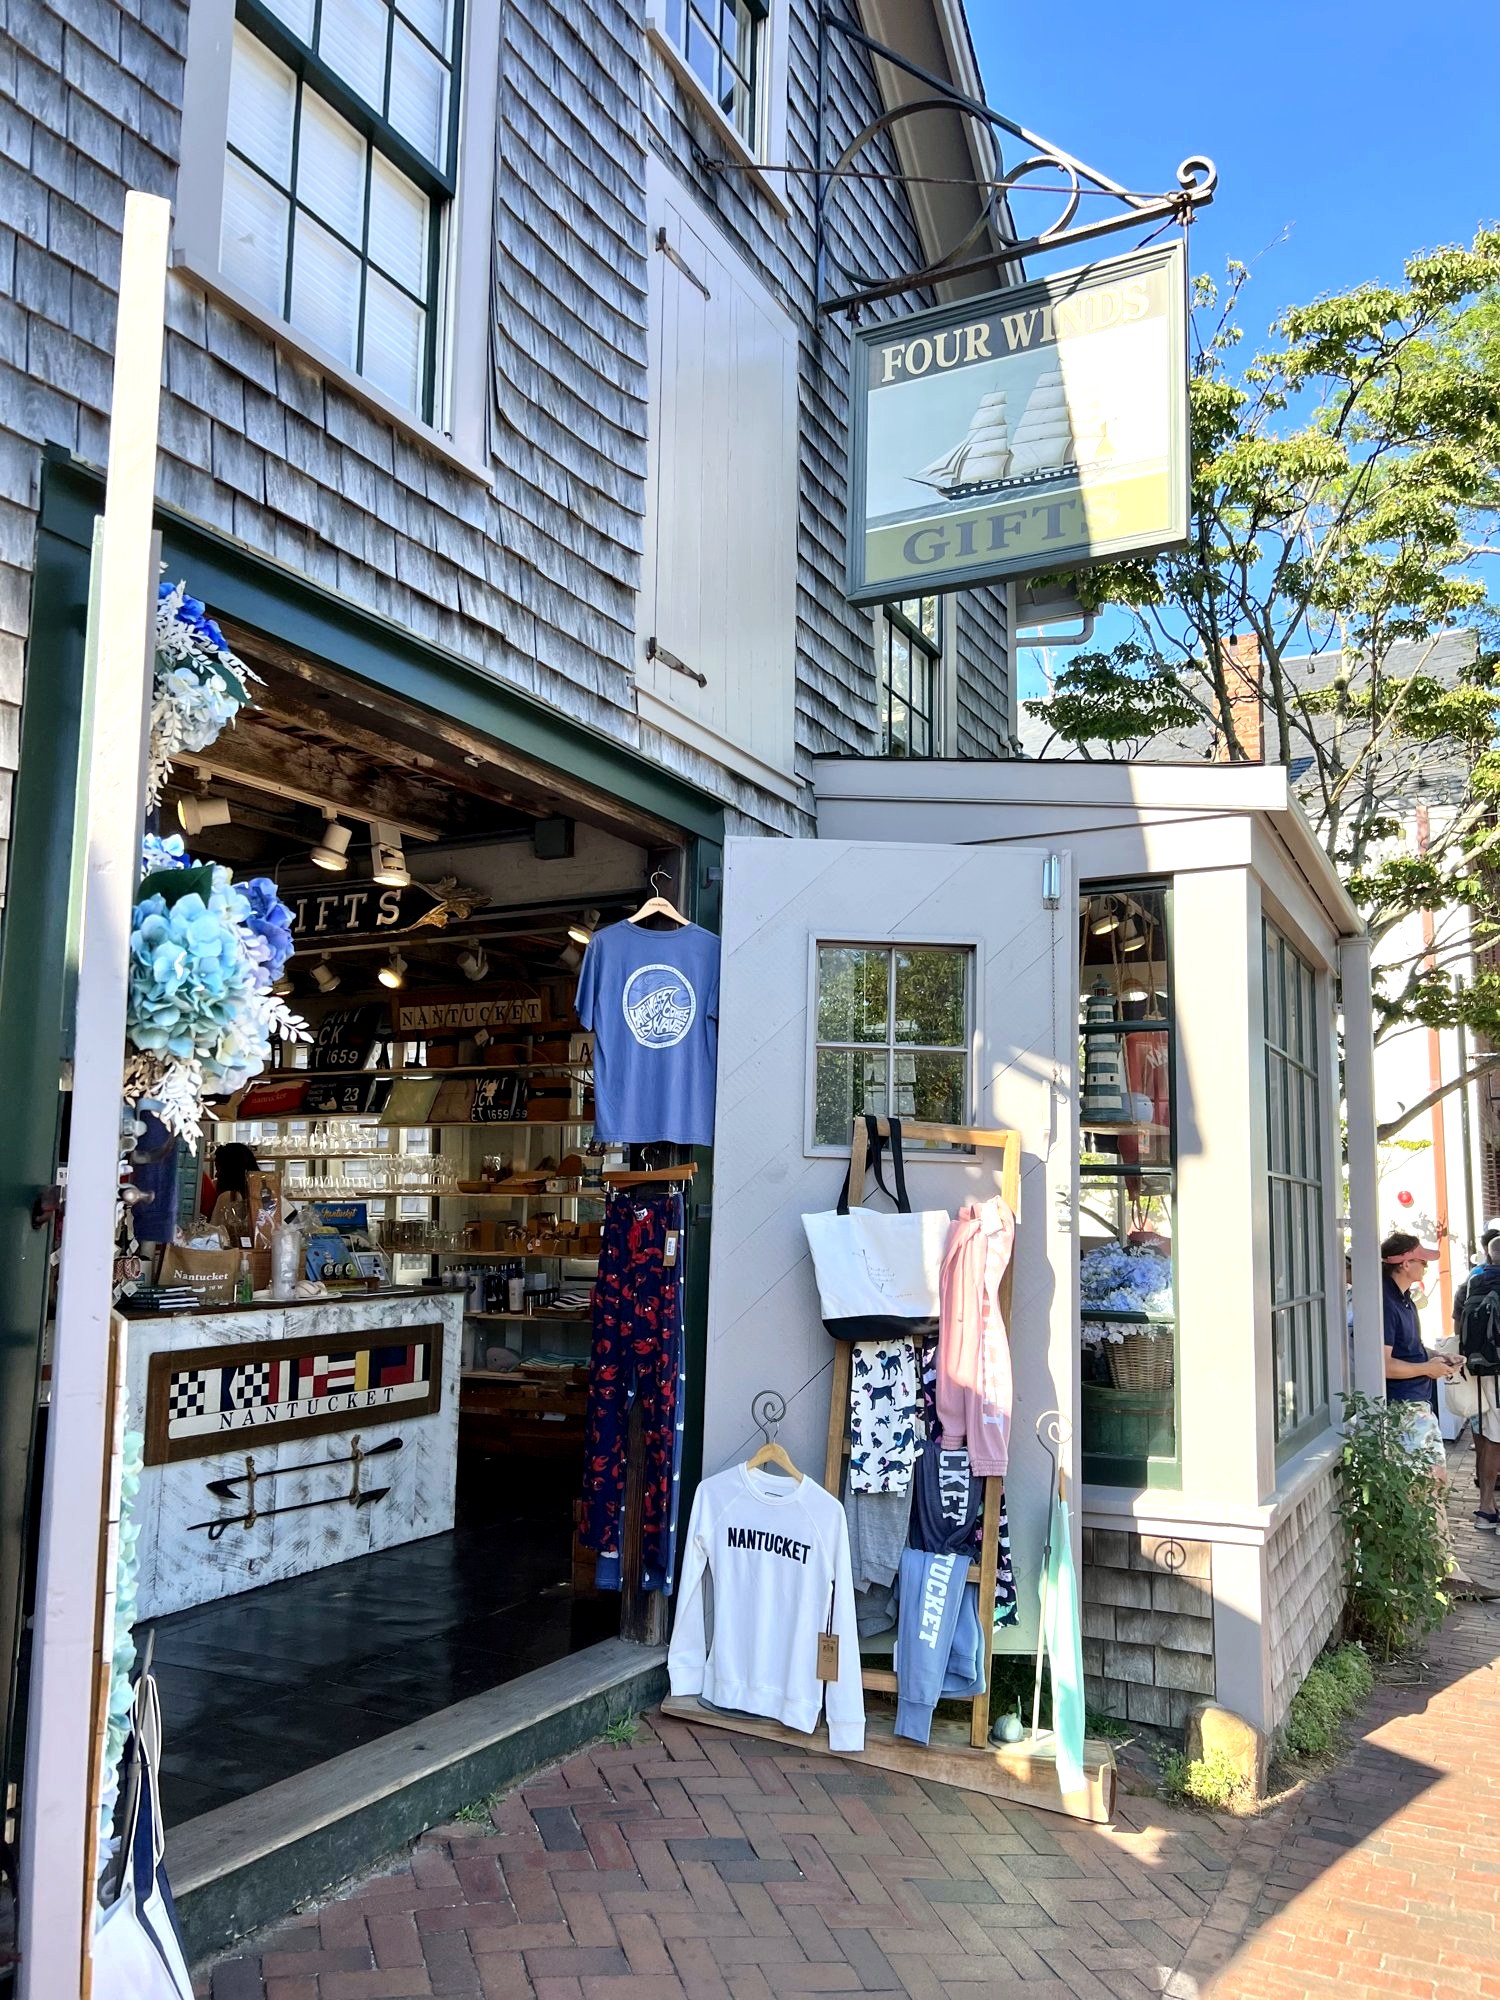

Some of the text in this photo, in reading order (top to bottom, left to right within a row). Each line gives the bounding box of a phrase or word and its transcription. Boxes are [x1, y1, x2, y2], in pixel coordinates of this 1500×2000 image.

[881, 278, 1150, 383] FOUR WINDS
[402, 1003, 539, 1026] NANTUCKET
[327, 1049, 359, 1064] 1659
[343, 1087, 360, 1102] 23
[487, 1109, 509, 1120] 1659
[174, 1269, 228, 1281] Nantucket
[219, 1387, 395, 1429] NANTUCKET
[727, 1526, 811, 1565] NANTUCKET
